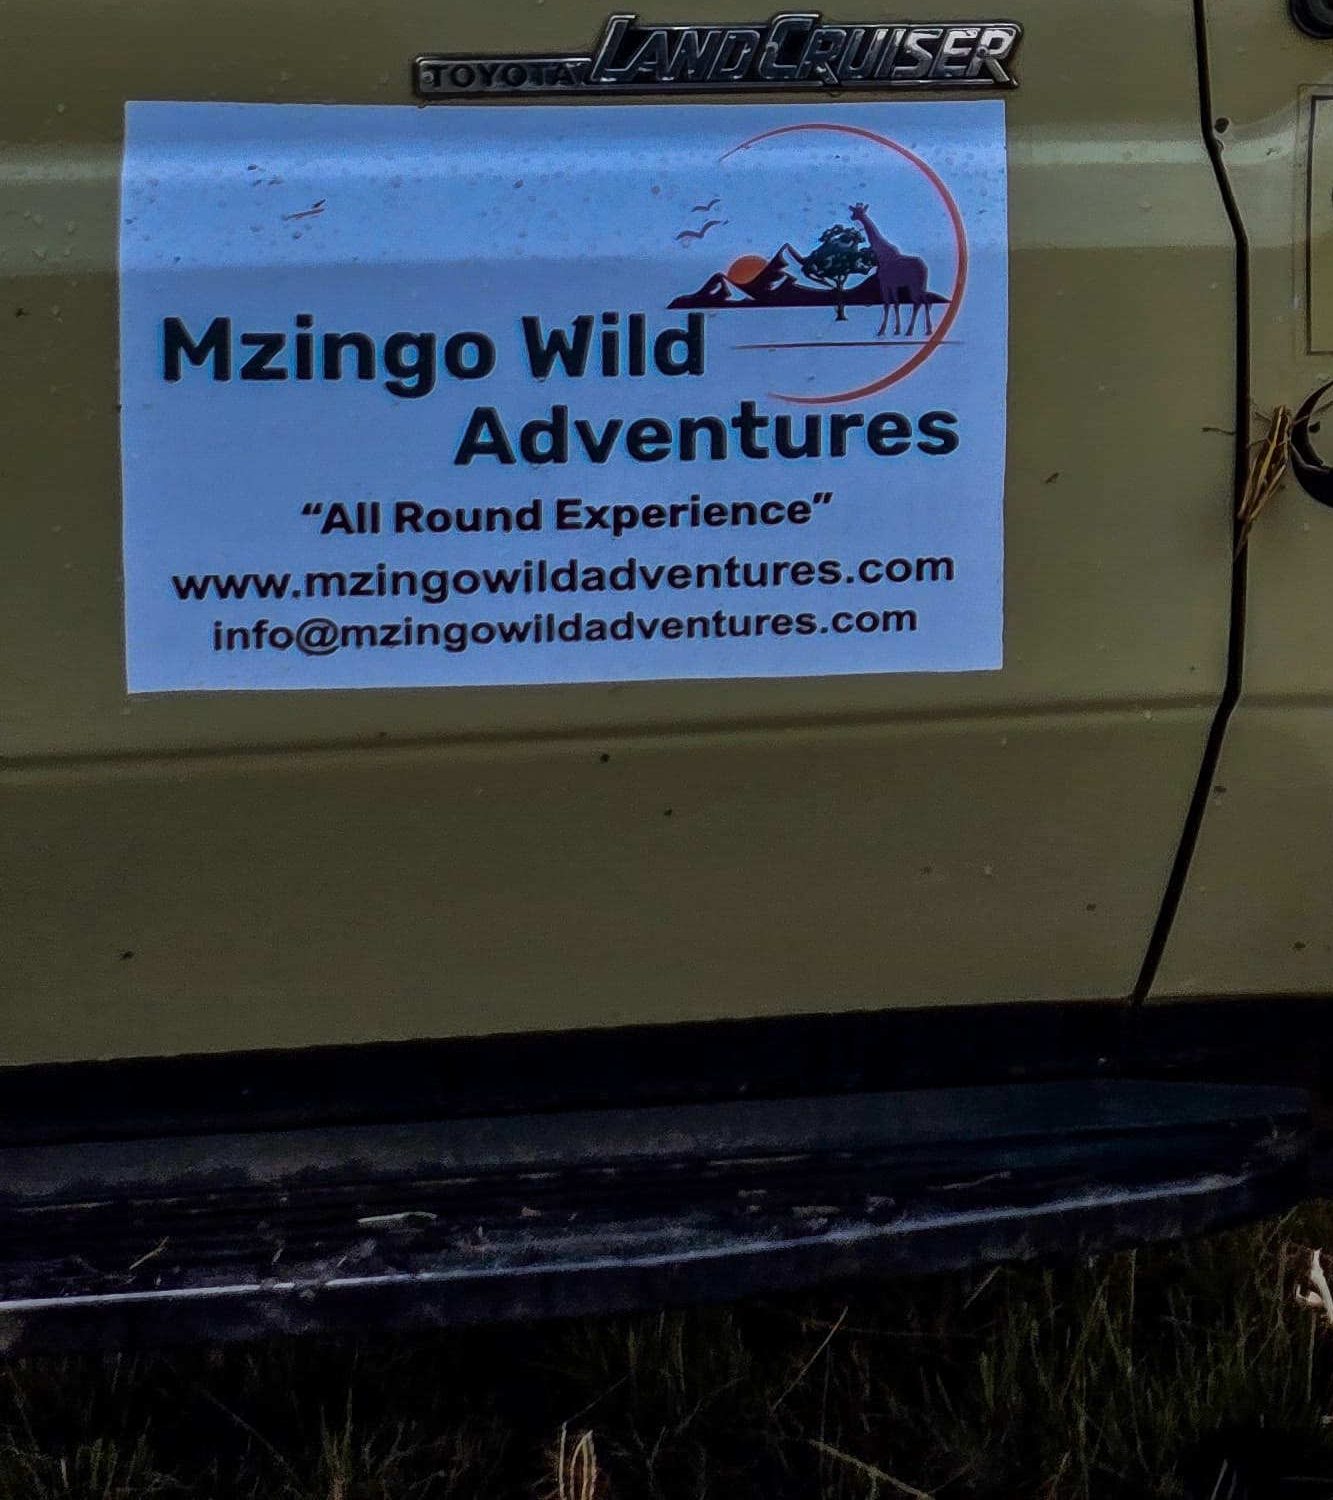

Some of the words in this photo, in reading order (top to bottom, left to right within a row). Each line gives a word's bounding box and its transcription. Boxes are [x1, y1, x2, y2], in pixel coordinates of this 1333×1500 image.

[427, 59, 583, 90] TOYOTA
[590, 13, 760, 83] LAND
[757, 12, 1016, 86] CRUISER
[161, 313, 495, 399] Mzingo
[522, 311, 707, 382] Wild
[453, 399, 961, 467] Adventures
[394, 498, 544, 535] Round
[172, 554, 955, 605] www.mzingowildadventures.com
[211, 607, 918, 656] info@mzingowildadventures.com
